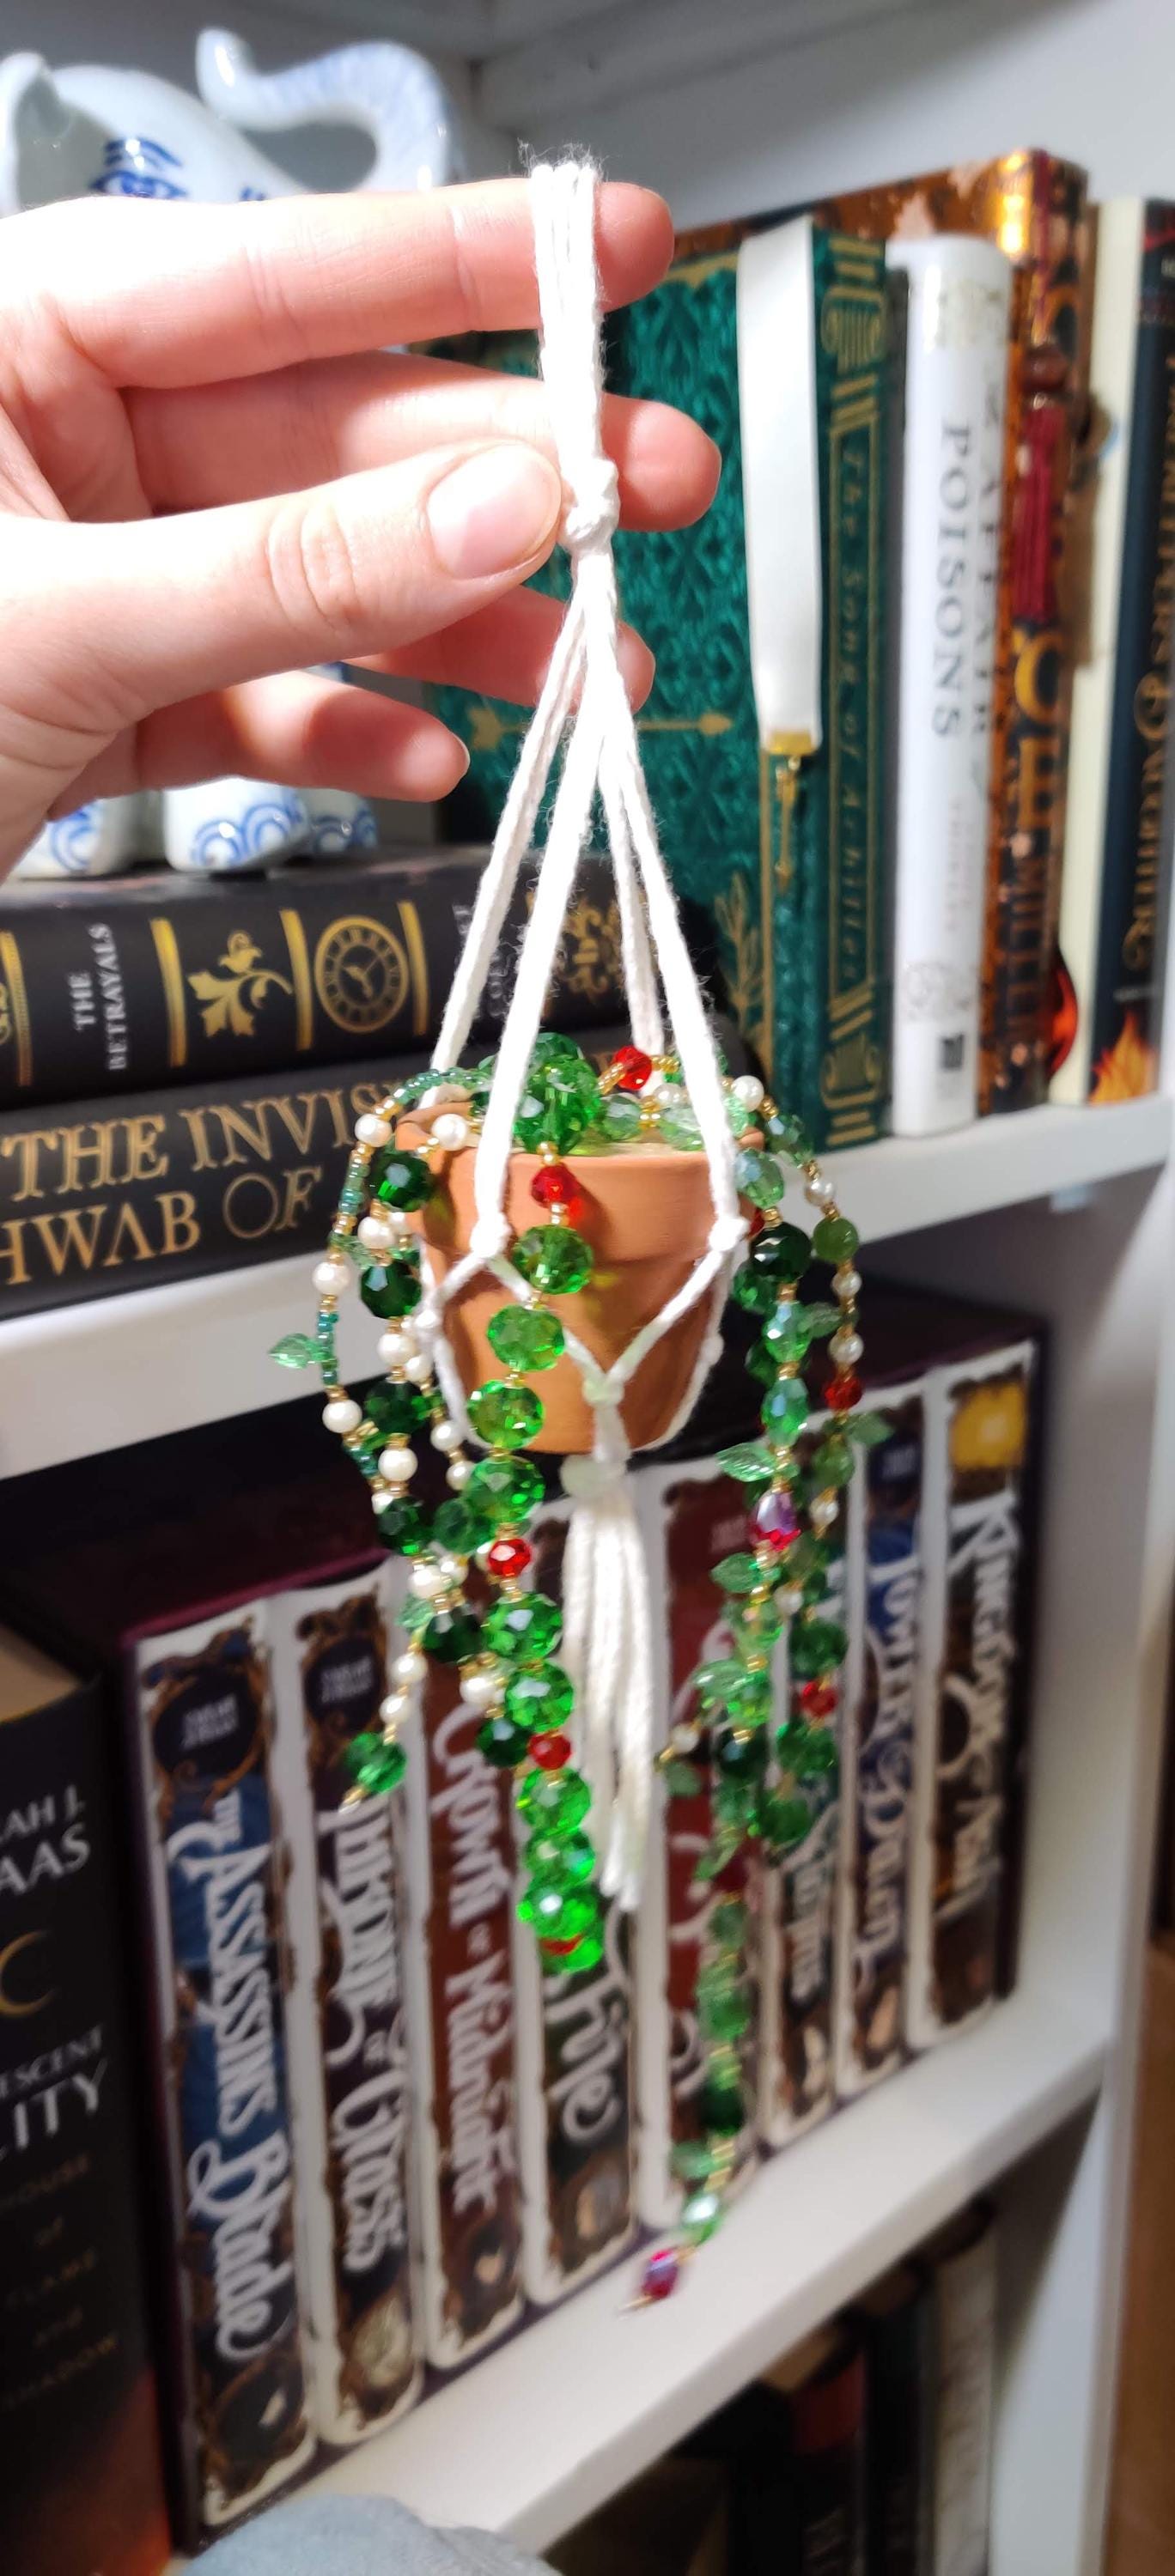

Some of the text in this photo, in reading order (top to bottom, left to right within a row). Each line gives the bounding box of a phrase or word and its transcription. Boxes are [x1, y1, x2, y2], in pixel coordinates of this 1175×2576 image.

[931, 423, 971, 738] POISONS
[70, 972, 96, 1031] THE
[88, 923, 128, 1070] BETRAYALS
[2, 1115, 169, 1201] THE
[222, 1163, 323, 1239] OF
